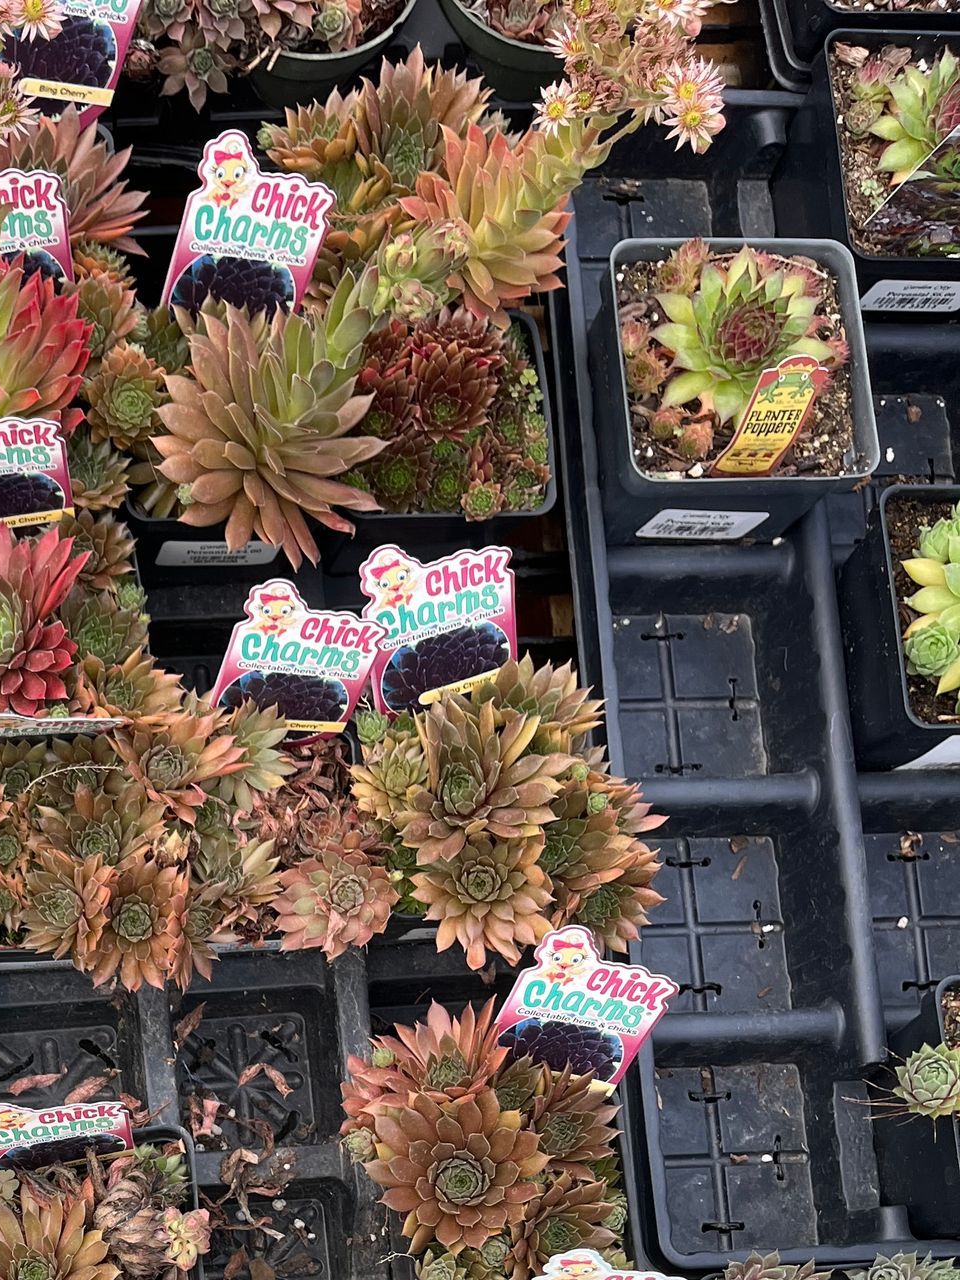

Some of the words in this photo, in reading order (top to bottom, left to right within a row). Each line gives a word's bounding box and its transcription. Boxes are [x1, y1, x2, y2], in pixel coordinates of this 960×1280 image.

[65, 5, 88, 16] hens
[99, 11, 127, 22] chicks
[40, 85, 58, 96] Bing
[251, 182, 327, 230] Chick
[29, 238, 58, 247] chicks
[191, 242, 241, 256] Collectable
[243, 250, 265, 260] hens
[277, 255, 305, 264] chicks
[749, 409, 802, 422] PLANTER
[425, 555, 505, 596] Chick
[300, 617, 379, 654] Chick
[383, 629, 436, 649] Collectable
[439, 621, 462, 634] hens
[464, 616, 472, 624] &
[474, 607, 504, 621] chicks
[239, 662, 291, 672] Collectable
[294, 667, 317, 676] hens
[329, 671, 357, 679] chicks
[586, 968, 669, 1011] Chick
[518, 1007, 571, 1022] Collectable
[573, 1017, 595, 1027] hens
[608, 1024, 638, 1035] chicks
[39, 1105, 119, 1125] Chick
